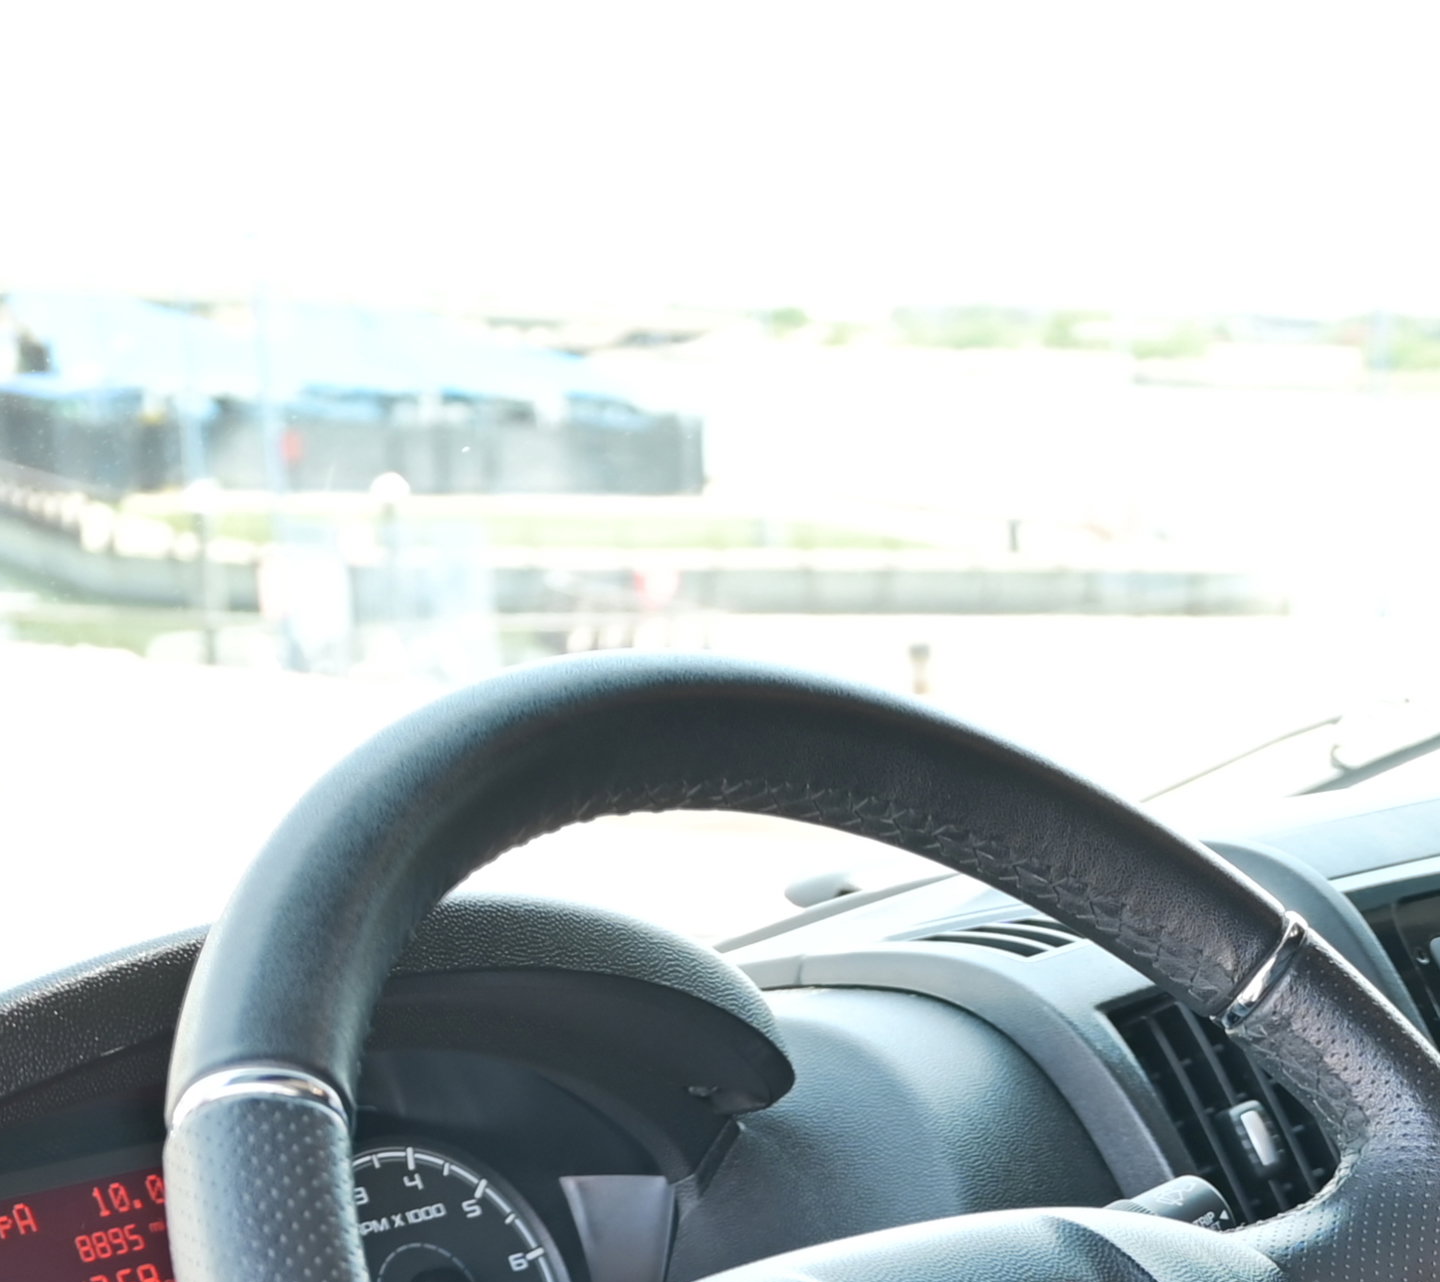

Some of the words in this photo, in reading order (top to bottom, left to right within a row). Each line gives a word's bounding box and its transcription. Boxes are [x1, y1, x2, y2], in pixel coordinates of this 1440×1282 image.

[403, 1173, 424, 1190] 4
[91, 1174, 166, 1217] 10.0
[359, 1219, 390, 1235] PM
[405, 1203, 447, 1224] 1000
[461, 1199, 482, 1218] 5
[75, 1224, 145, 1263] 8895
[508, 1252, 529, 1271] 6
